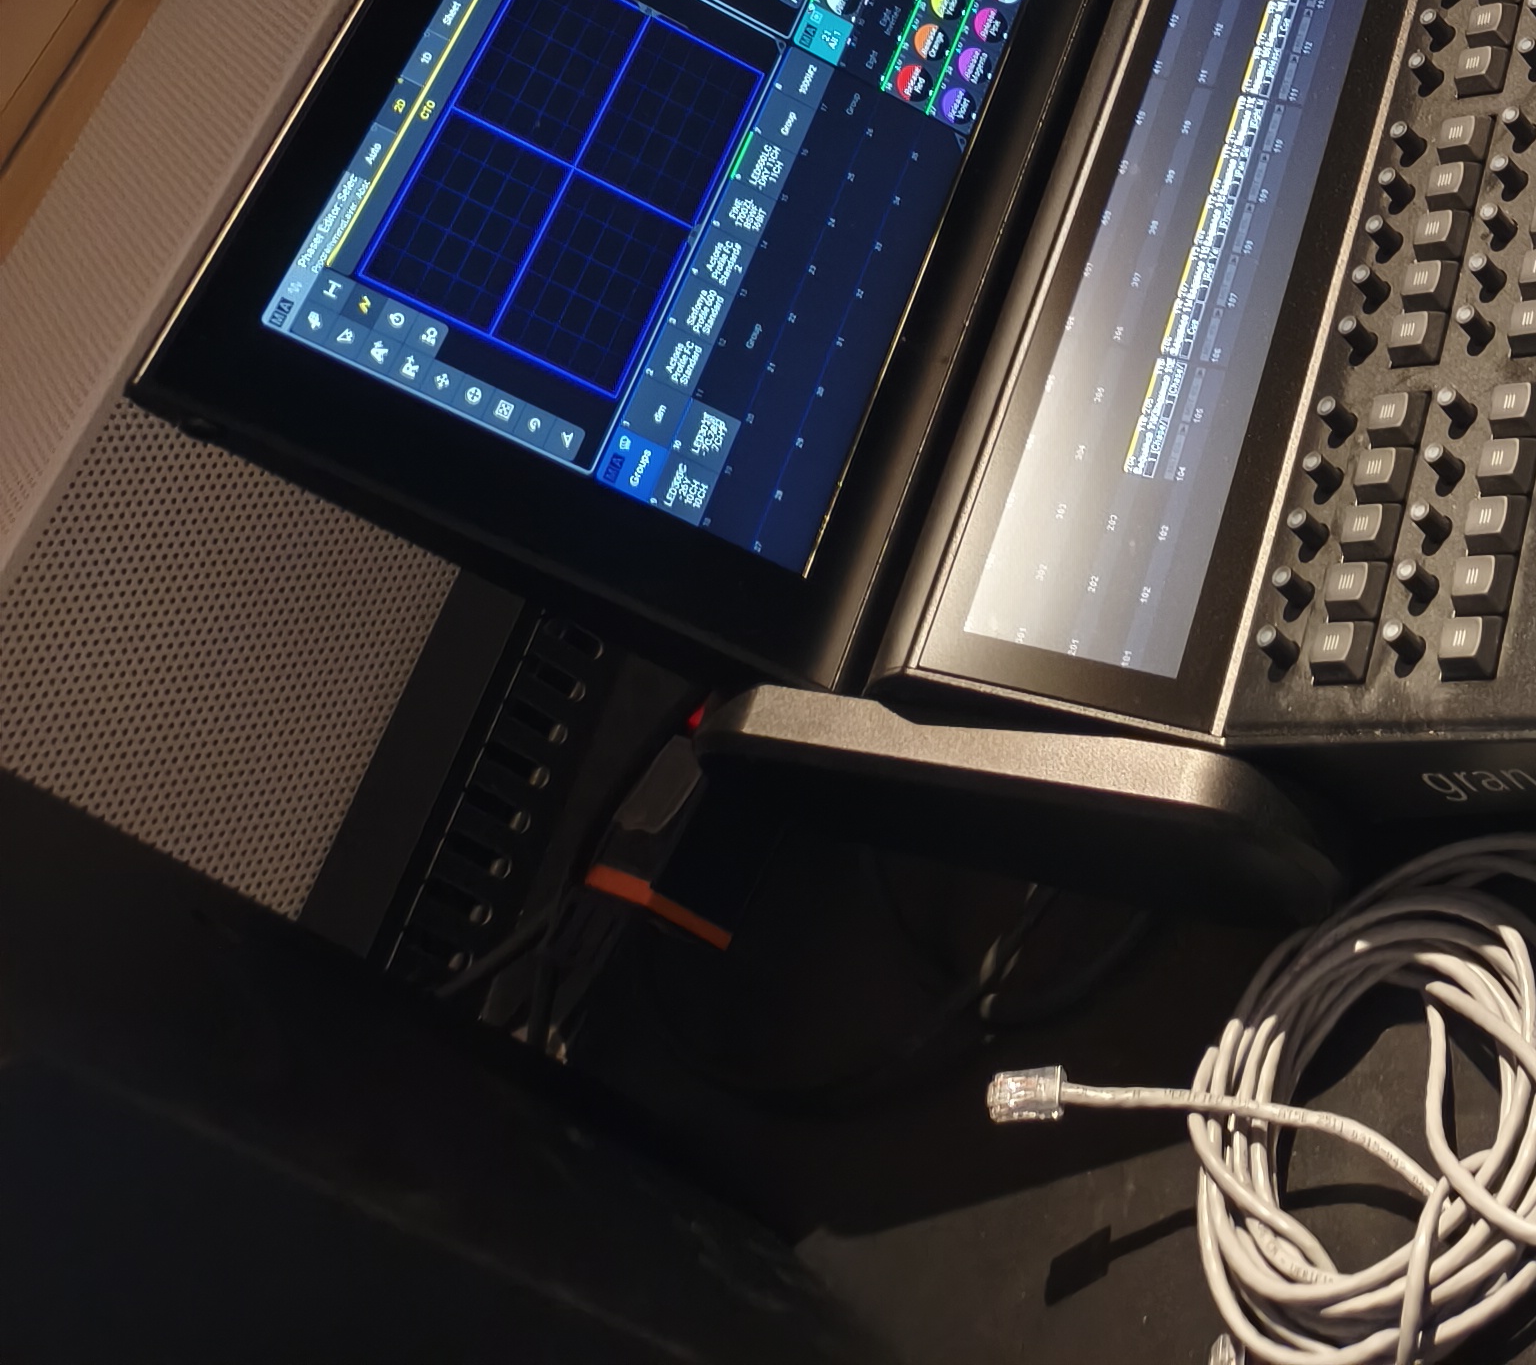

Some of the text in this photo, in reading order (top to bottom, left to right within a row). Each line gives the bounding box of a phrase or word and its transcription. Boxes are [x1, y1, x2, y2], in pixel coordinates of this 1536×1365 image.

[440, 0, 463, 27] Sheet
[1168, 13, 1180, 28] 412
[820, 28, 833, 42] 21
[988, 18, 1002, 37] Pink
[827, 35, 840, 50] All
[927, 30, 945, 59] Orange
[1302, 40, 1314, 55] 112
[418, 49, 434, 66] 1D
[864, 48, 880, 70] Eight
[969, 50, 989, 85] Magenta
[1152, 59, 1164, 74] 411
[903, 64, 922, 96] Release
[912, 75, 926, 94] Red
[1197, 68, 1209, 84] 311
[844, 90, 862, 116] Group
[1288, 86, 1300, 102] 111
[392, 97, 409, 114] 2D
[417, 97, 438, 122] CTO
[955, 96, 971, 120] Violet
[779, 109, 798, 137] Group
[363, 140, 384, 165] Auto
[765, 145, 782, 169] 11CH
[767, 159, 785, 184] 11CH
[296, 230, 326, 269] Phaser
[710, 239, 735, 281] Profile FC
[1226, 292, 1239, 308] 107
[691, 288, 718, 335] Profile 600
[700, 294, 726, 336] Standard
[744, 321, 764, 351] Group
[664, 340, 685, 374] Actoris
[670, 339, 696, 383] Profile FC
[678, 344, 704, 386] Standard
[651, 402, 668, 424] dim
[627, 446, 654, 489] Groups
[1173, 465, 1187, 482] 104
[683, 478, 701, 506] 10CH
[691, 481, 710, 510] 10CH
[1054, 502, 1068, 520] 303
[1105, 514, 1118, 531] 203
[1156, 524, 1170, 542] 103
[1034, 563, 1049, 581] 302
[1086, 574, 1100, 593] 202
[1137, 585, 1152, 605] 102
[1066, 637, 1080, 656] 201
[1119, 649, 1133, 667] 101
